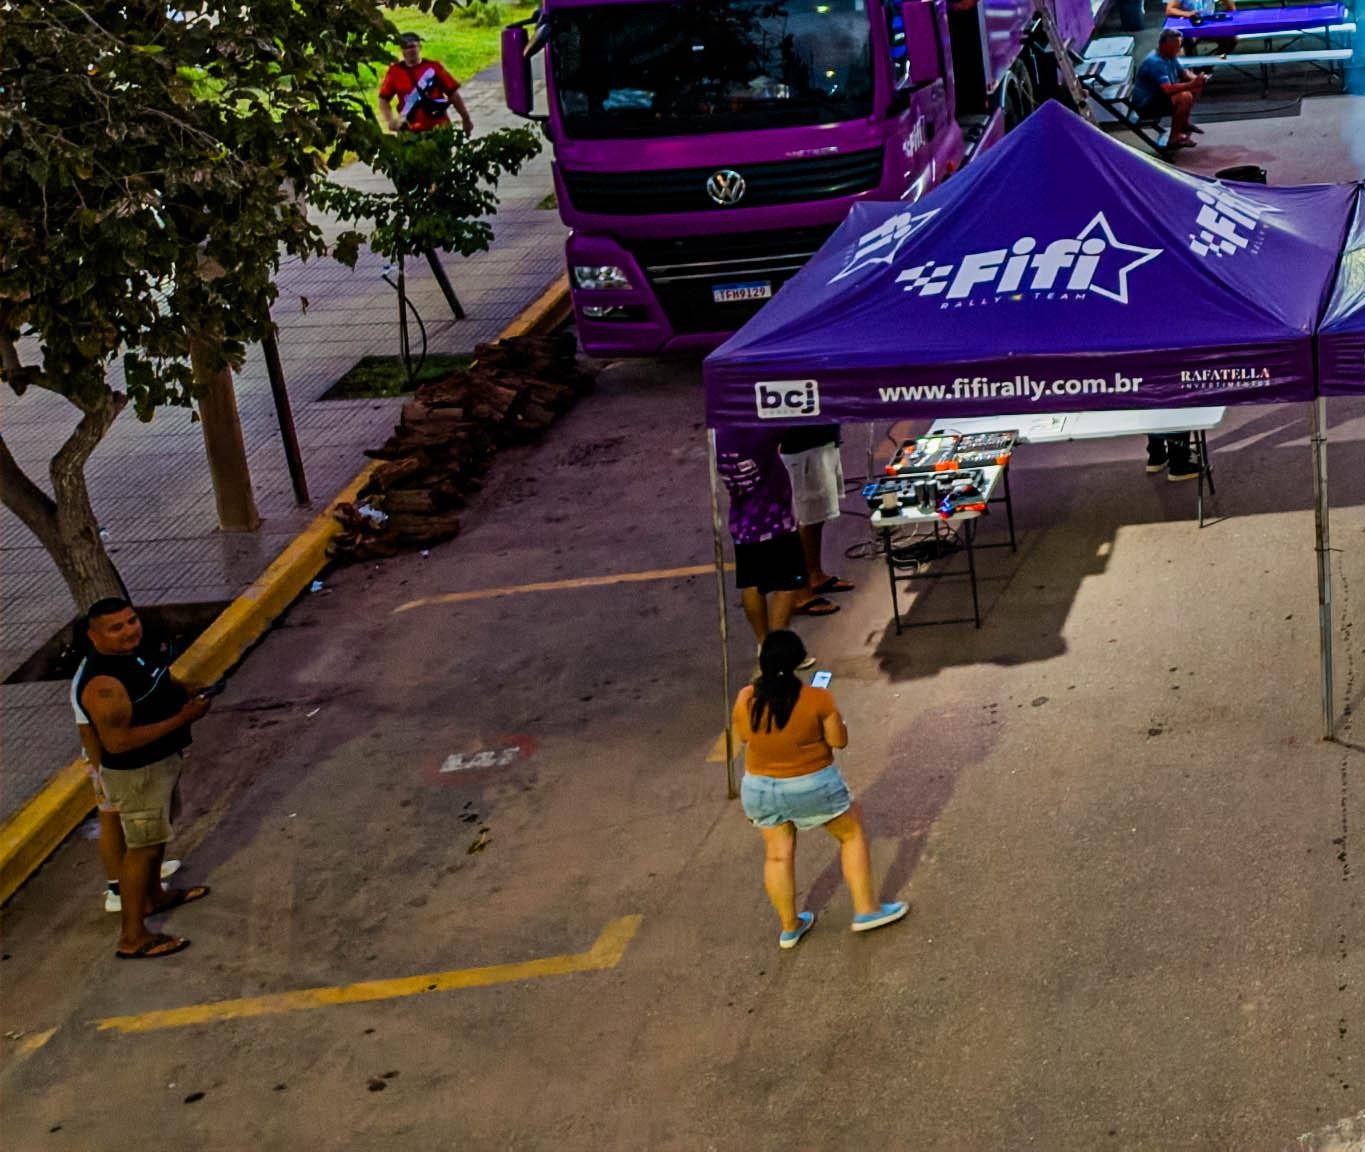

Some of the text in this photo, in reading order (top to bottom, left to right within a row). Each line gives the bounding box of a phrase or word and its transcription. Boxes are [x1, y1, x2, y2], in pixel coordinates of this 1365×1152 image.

[946, 236, 1106, 299] Fifi
[940, 292, 1087, 310] RALLY TEAM
[878, 372, 1143, 402] www.fifirally.com.br
[1180, 367, 1271, 382] RAFATELLA
[759, 381, 816, 414] bcj
